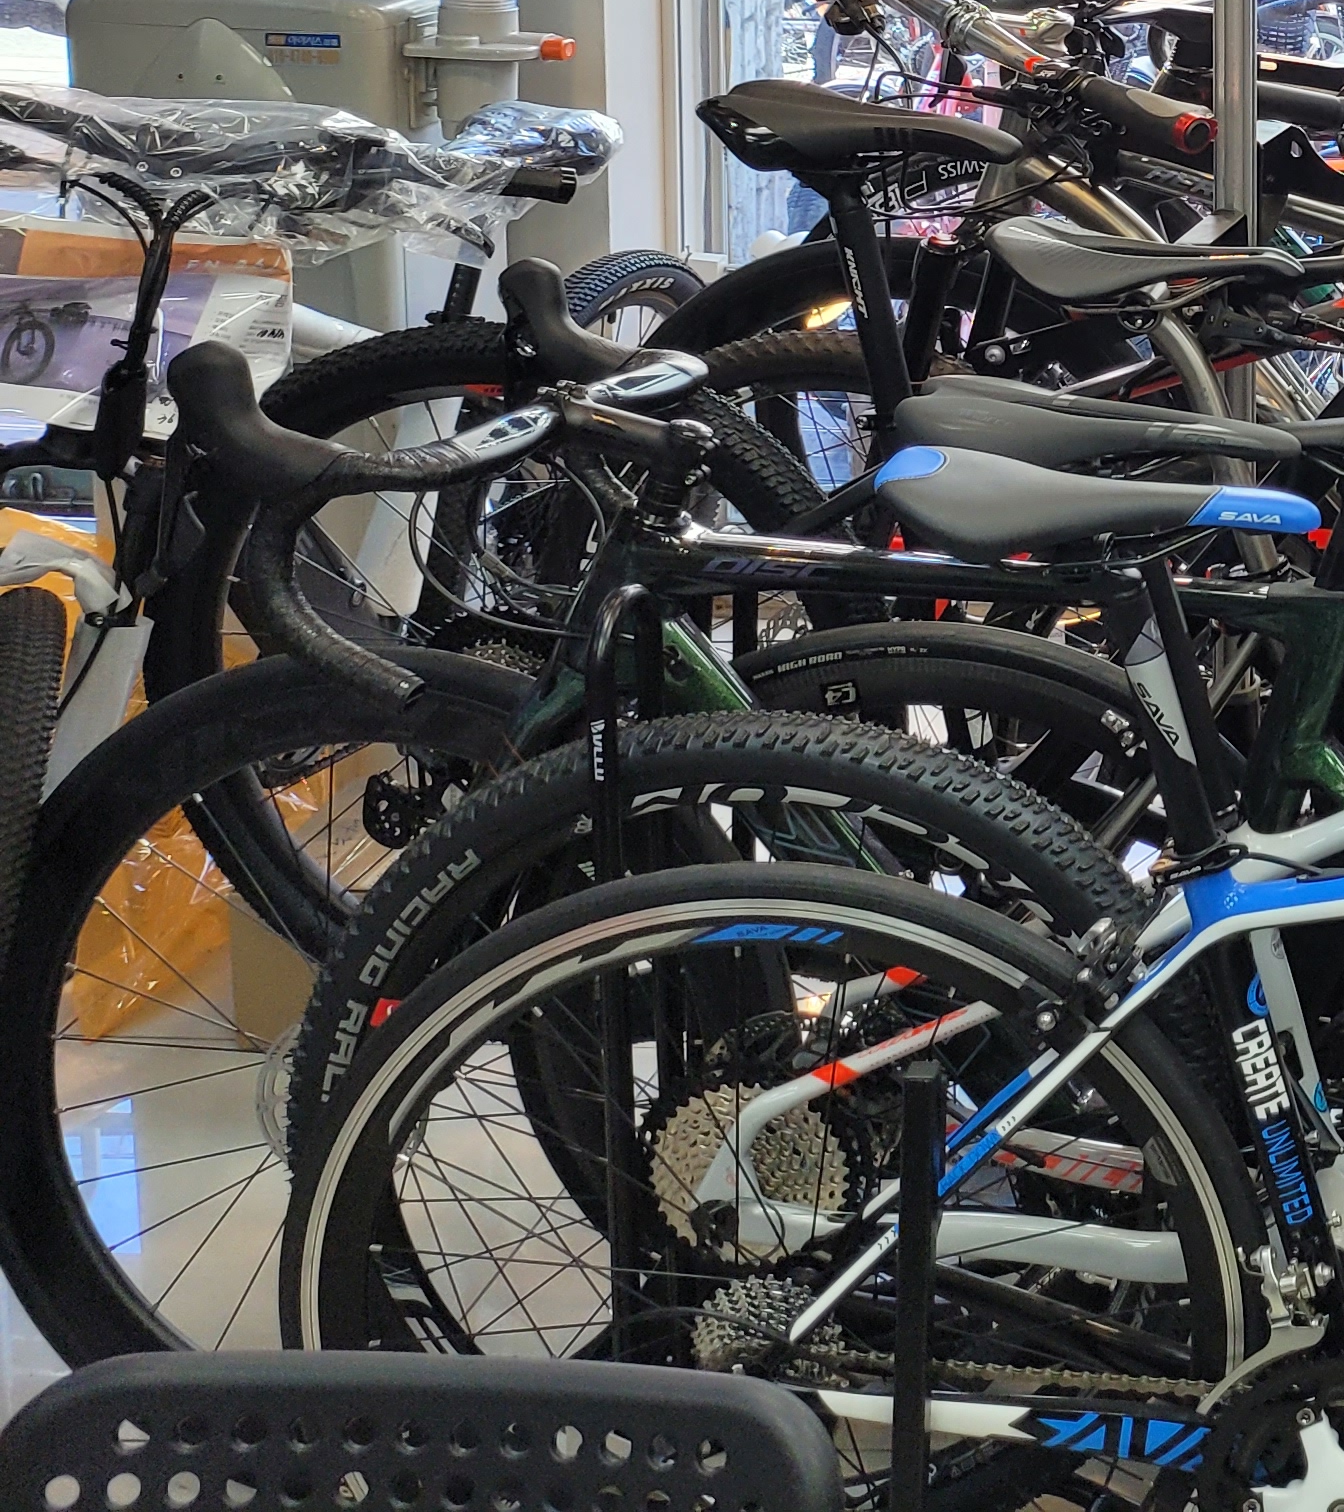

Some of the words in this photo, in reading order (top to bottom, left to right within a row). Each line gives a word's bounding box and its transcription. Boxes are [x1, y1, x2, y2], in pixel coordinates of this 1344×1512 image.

[1217, 511, 1282, 525] SAVA
[704, 555, 844, 581] DISC
[777, 657, 807, 674] HIGH
[809, 651, 843, 665] ROAD
[1136, 681, 1180, 747] SAVA
[359, 846, 482, 989] RACING
[320, 999, 369, 1103] RAL
[1232, 1021, 1291, 1122] CREATE
[1260, 1120, 1313, 1227] UNLIMITED
